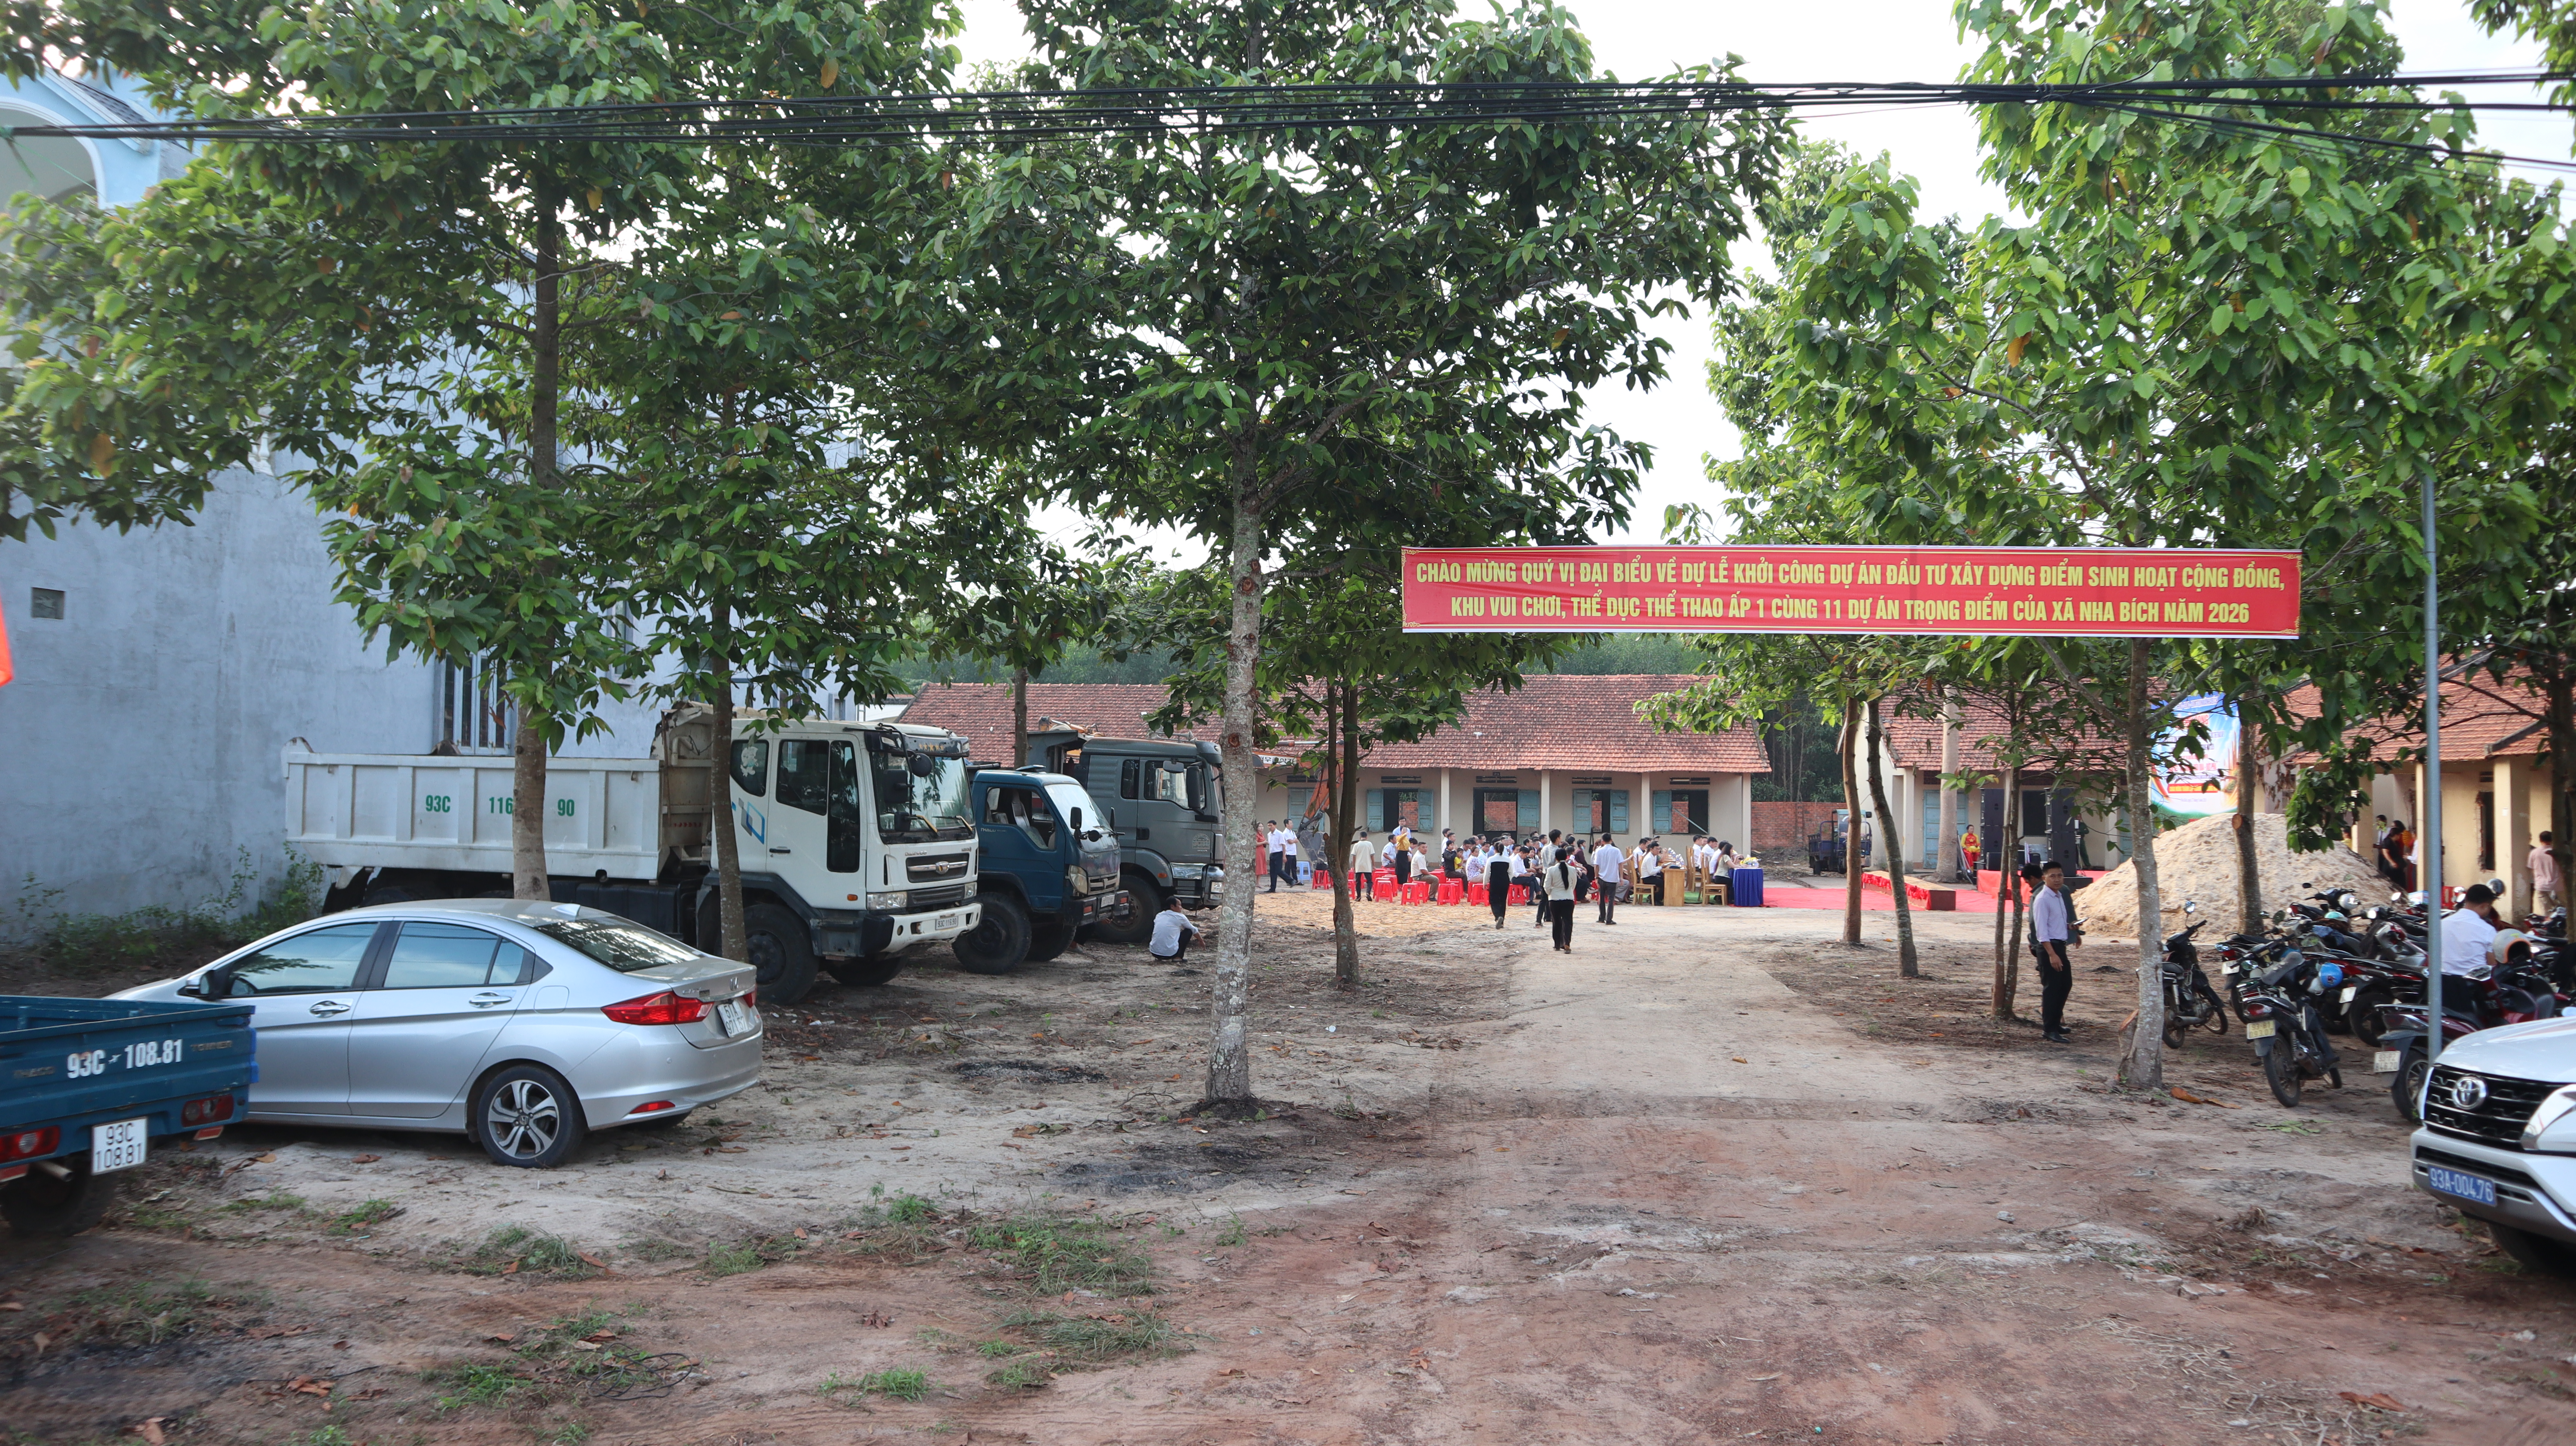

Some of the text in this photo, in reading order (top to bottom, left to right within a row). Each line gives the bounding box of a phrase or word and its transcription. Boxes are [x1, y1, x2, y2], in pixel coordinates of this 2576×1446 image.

[1416, 555, 2284, 592] CHÀO MỪNG QUÝ VỊ ĐẠI BIỂU VỀ DỰ LỄ KHỞI CÔNG DỰ ÁN ĐẦU TƯ XÂY DỰNG ĐIỂM SINH HOẠT CỘNG ĐỒNG,
[1451, 589, 2249, 624] KHU VUI CHƠI, THỂ DỤC THỂ THAO ẤP 1 CÙNG 11 DỰ ÁN TRỌNG ĐIỂM CỦA XÃ NHA BÍCH NĂM 2026
[425, 795, 574, 816] 93C 116 90
[67, 1049, 106, 1078] 93C
[106, 1122, 134, 1146] 93C
[95, 1142, 142, 1171] 108.81
[2430, 1168, 2494, 1202] 93A-004.76
